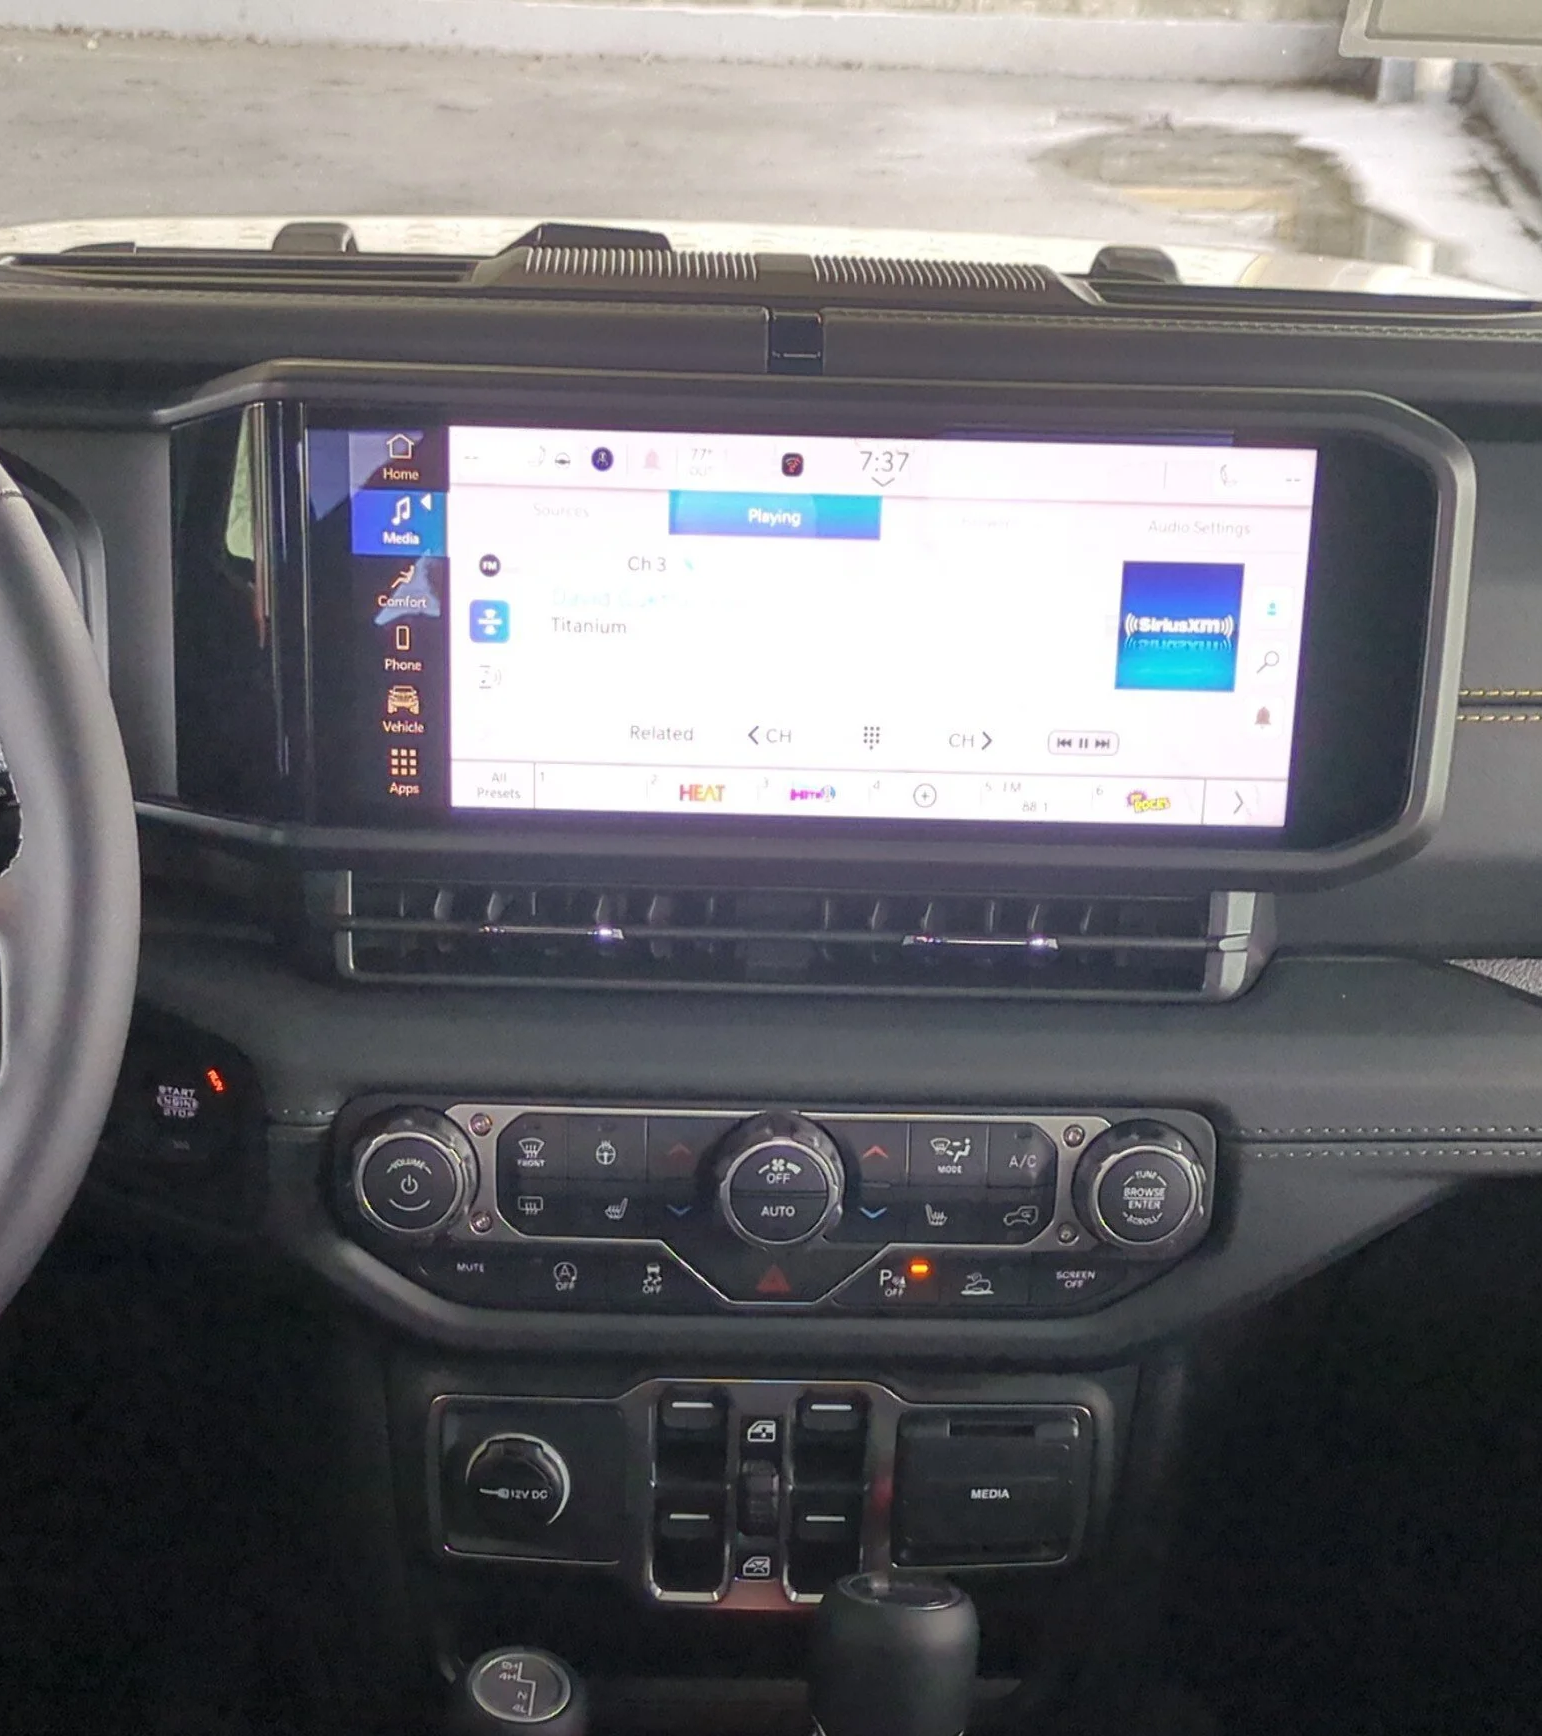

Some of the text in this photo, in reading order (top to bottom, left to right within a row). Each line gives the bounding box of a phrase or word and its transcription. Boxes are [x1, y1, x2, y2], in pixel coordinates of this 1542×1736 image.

[859, 450, 910, 473] 7:37
[382, 466, 420, 482] Home
[533, 502, 590, 518] Sources
[747, 507, 802, 527] Playing
[1148, 520, 1252, 538] Audio Settings
[382, 531, 420, 546] Media
[627, 556, 667, 573] Ch 3
[377, 594, 427, 609] Comfort
[551, 616, 628, 636] Titanium
[384, 658, 422, 673] Phone
[382, 719, 425, 735] Vehicle
[630, 725, 695, 742] Related
[765, 728, 793, 744] CH
[948, 732, 975, 749] CH
[490, 771, 508, 784] All
[388, 781, 420, 797] Apps
[476, 785, 522, 801] Presets
[679, 784, 726, 802] HEAT
[1095, 784, 1105, 796] 6
[516, 1159, 547, 1169] FRONT
[1008, 1153, 1038, 1170] A/C
[937, 1165, 964, 1175] MODE
[765, 1173, 791, 1185] OFF
[1123, 1186, 1166, 1198] BROWSE
[760, 1205, 796, 1218] AUTO
[1127, 1200, 1161, 1211] ENTER
[456, 1263, 485, 1274] MUTE
[1055, 1270, 1096, 1280] SCREEN
[879, 1269, 893, 1287] P
[1064, 1279, 1084, 1289] OFF
[555, 1281, 576, 1292] OFF
[641, 1284, 663, 1295] OFF
[884, 1287, 905, 1298] OFF
[510, 1488, 549, 1501] 12V DC
[970, 1488, 1011, 1500] MEDIA
[516, 1690, 528, 1701] N
